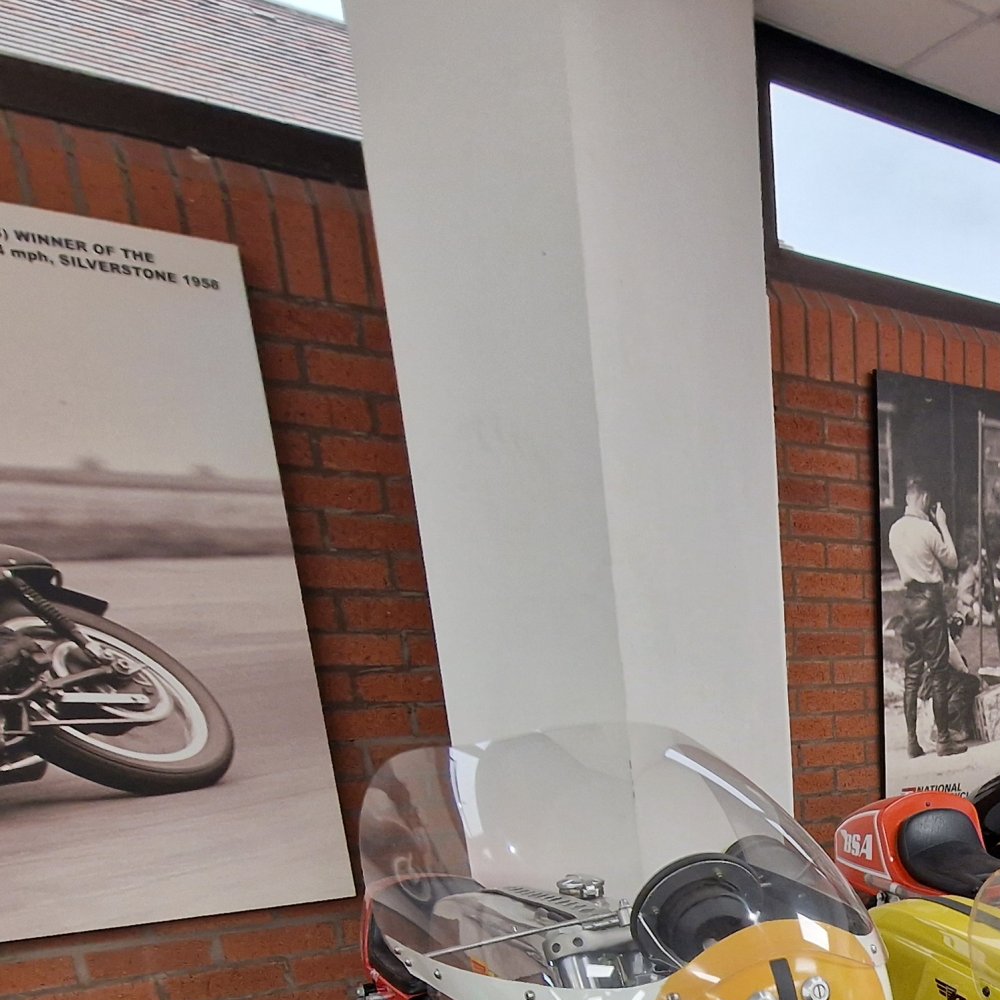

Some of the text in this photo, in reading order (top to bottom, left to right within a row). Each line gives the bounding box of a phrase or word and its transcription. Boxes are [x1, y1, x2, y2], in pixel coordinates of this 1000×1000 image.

[14, 229, 87, 252] WINNER
[94, 243, 115, 257] OF
[121, 247, 155, 264] THE
[10, 249, 54, 265] mph,
[58, 253, 178, 284] SILVERSTONE
[842, 830, 873, 861] BSA
